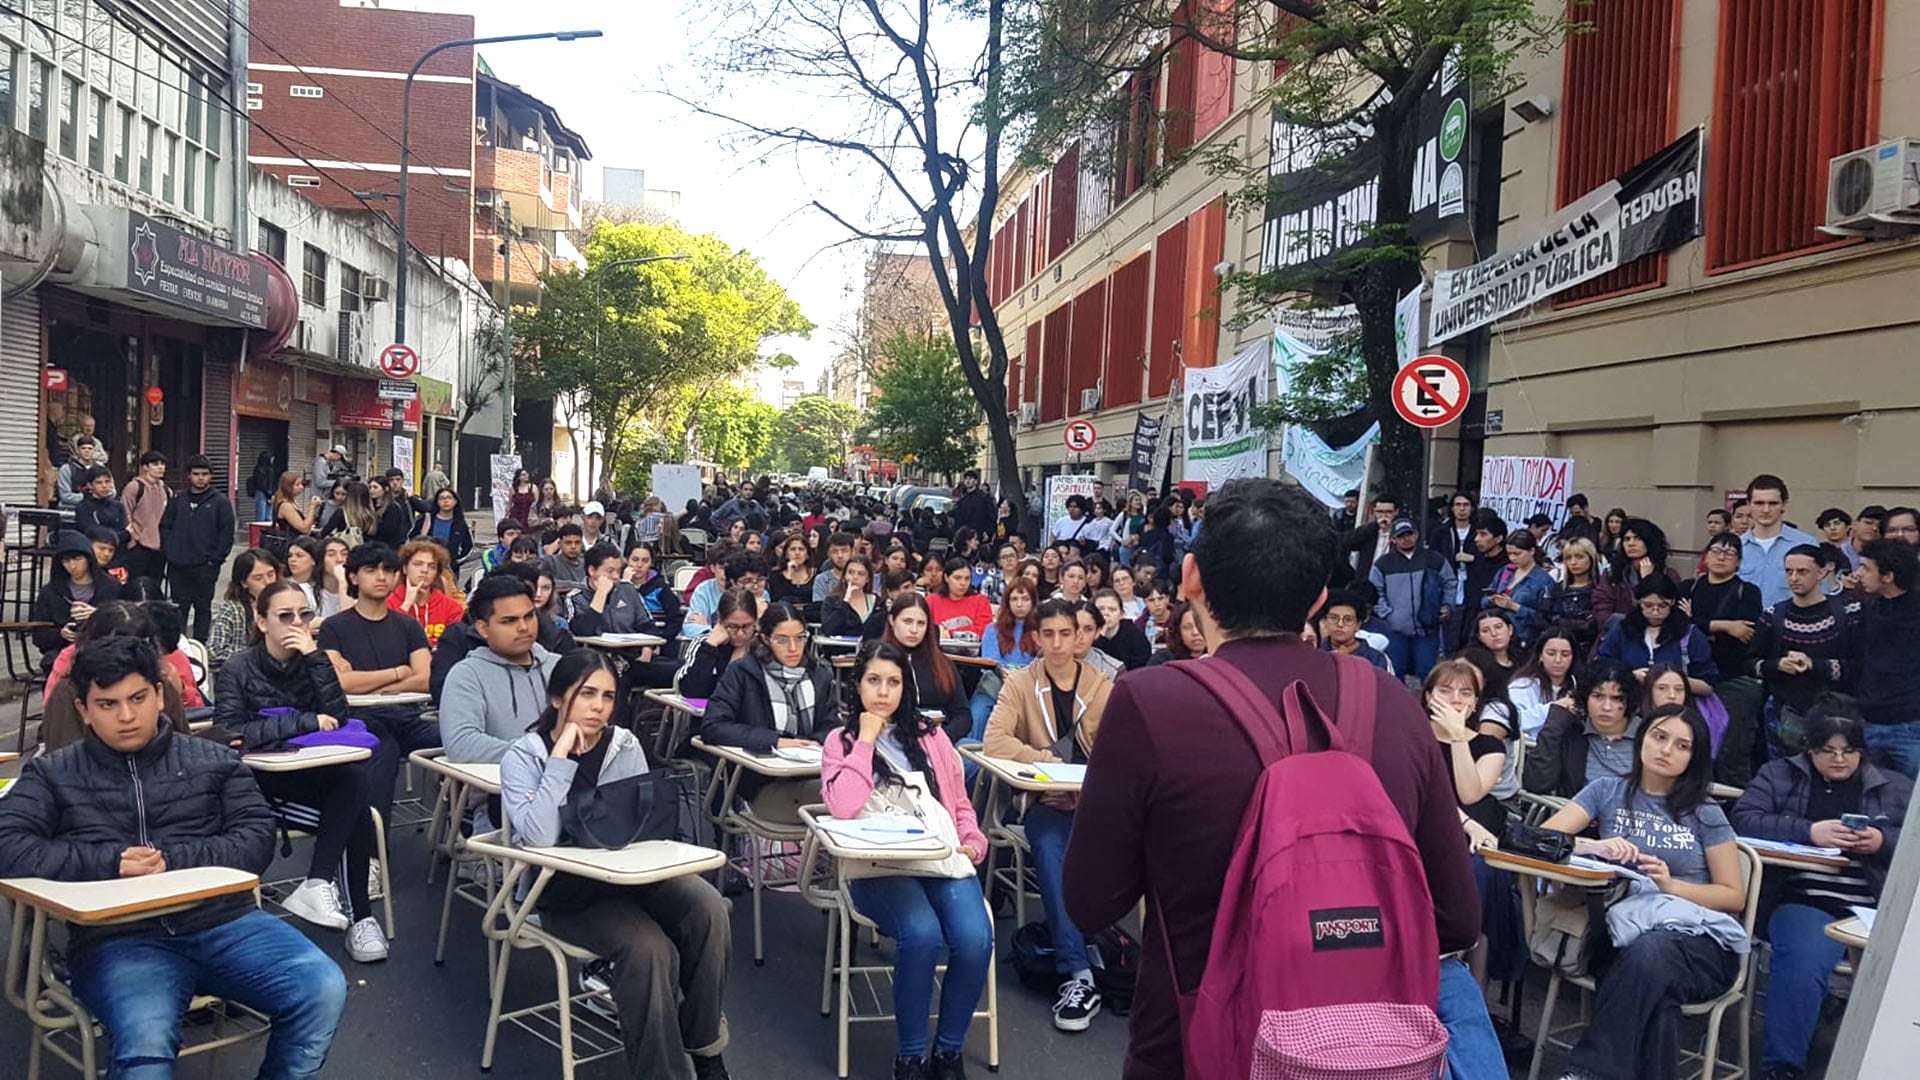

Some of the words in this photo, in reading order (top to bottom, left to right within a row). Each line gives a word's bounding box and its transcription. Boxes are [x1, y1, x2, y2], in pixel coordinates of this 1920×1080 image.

[1620, 171, 1698, 230] FEDUBA
[1260, 218, 1277, 275] LA
[1311, 200, 1333, 259] NO
[1449, 271, 1468, 299] EN
[1569, 212, 1600, 239] LA
[1434, 271, 1531, 337] UNIVERSIDAD
[1532, 231, 1614, 296] PÚBLICA
[1416, 369, 1446, 406] E
[1074, 426, 1086, 442] E
[1520, 459, 1567, 502] TOMADA
[1615, 815, 1647, 829] NEW
[1316, 918, 1379, 940] JANSPORT
